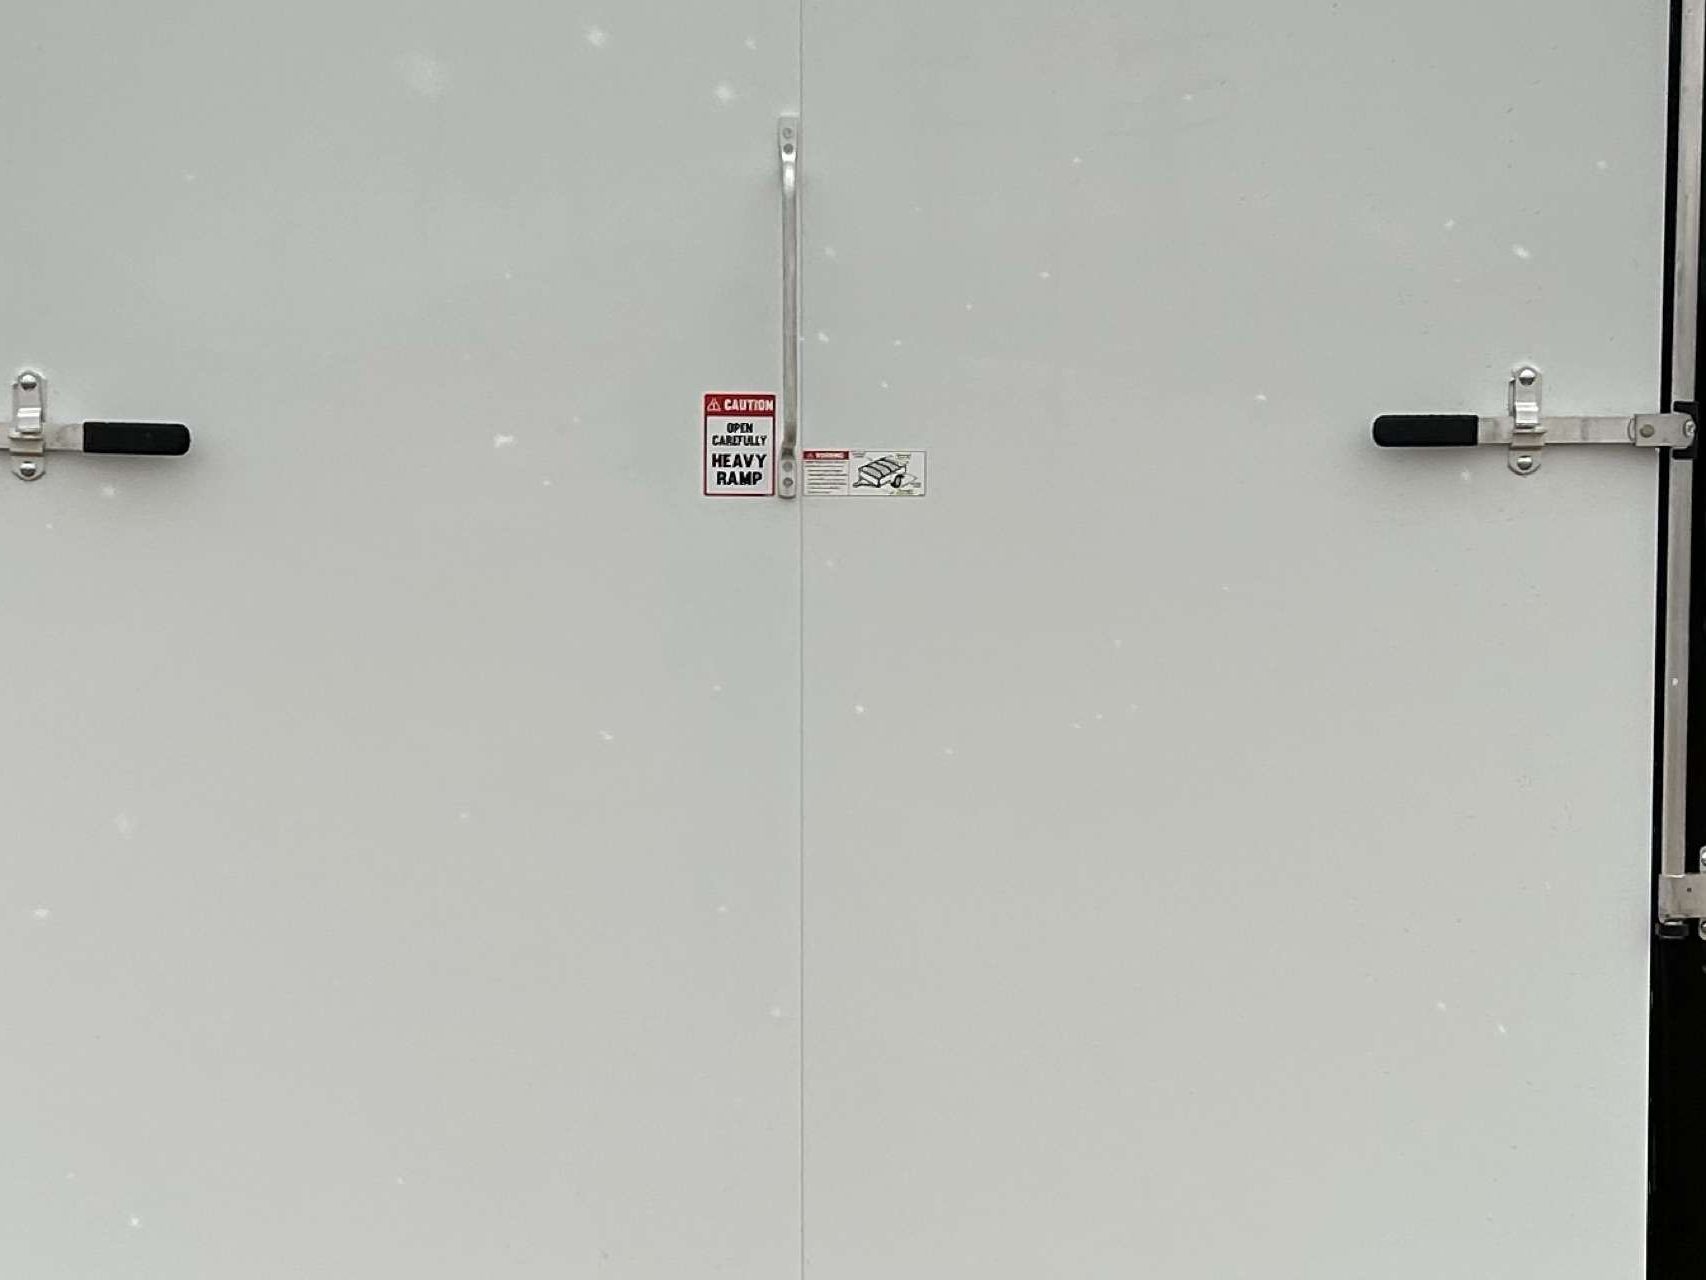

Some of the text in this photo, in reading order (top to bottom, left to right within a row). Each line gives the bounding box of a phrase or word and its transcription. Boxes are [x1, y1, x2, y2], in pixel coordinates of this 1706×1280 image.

[724, 399, 774, 411] CAUTION
[726, 422, 754, 433] OPEN
[711, 435, 768, 446] CAREFULLY
[711, 453, 768, 468] HEAVY
[716, 471, 763, 486] RAMP
